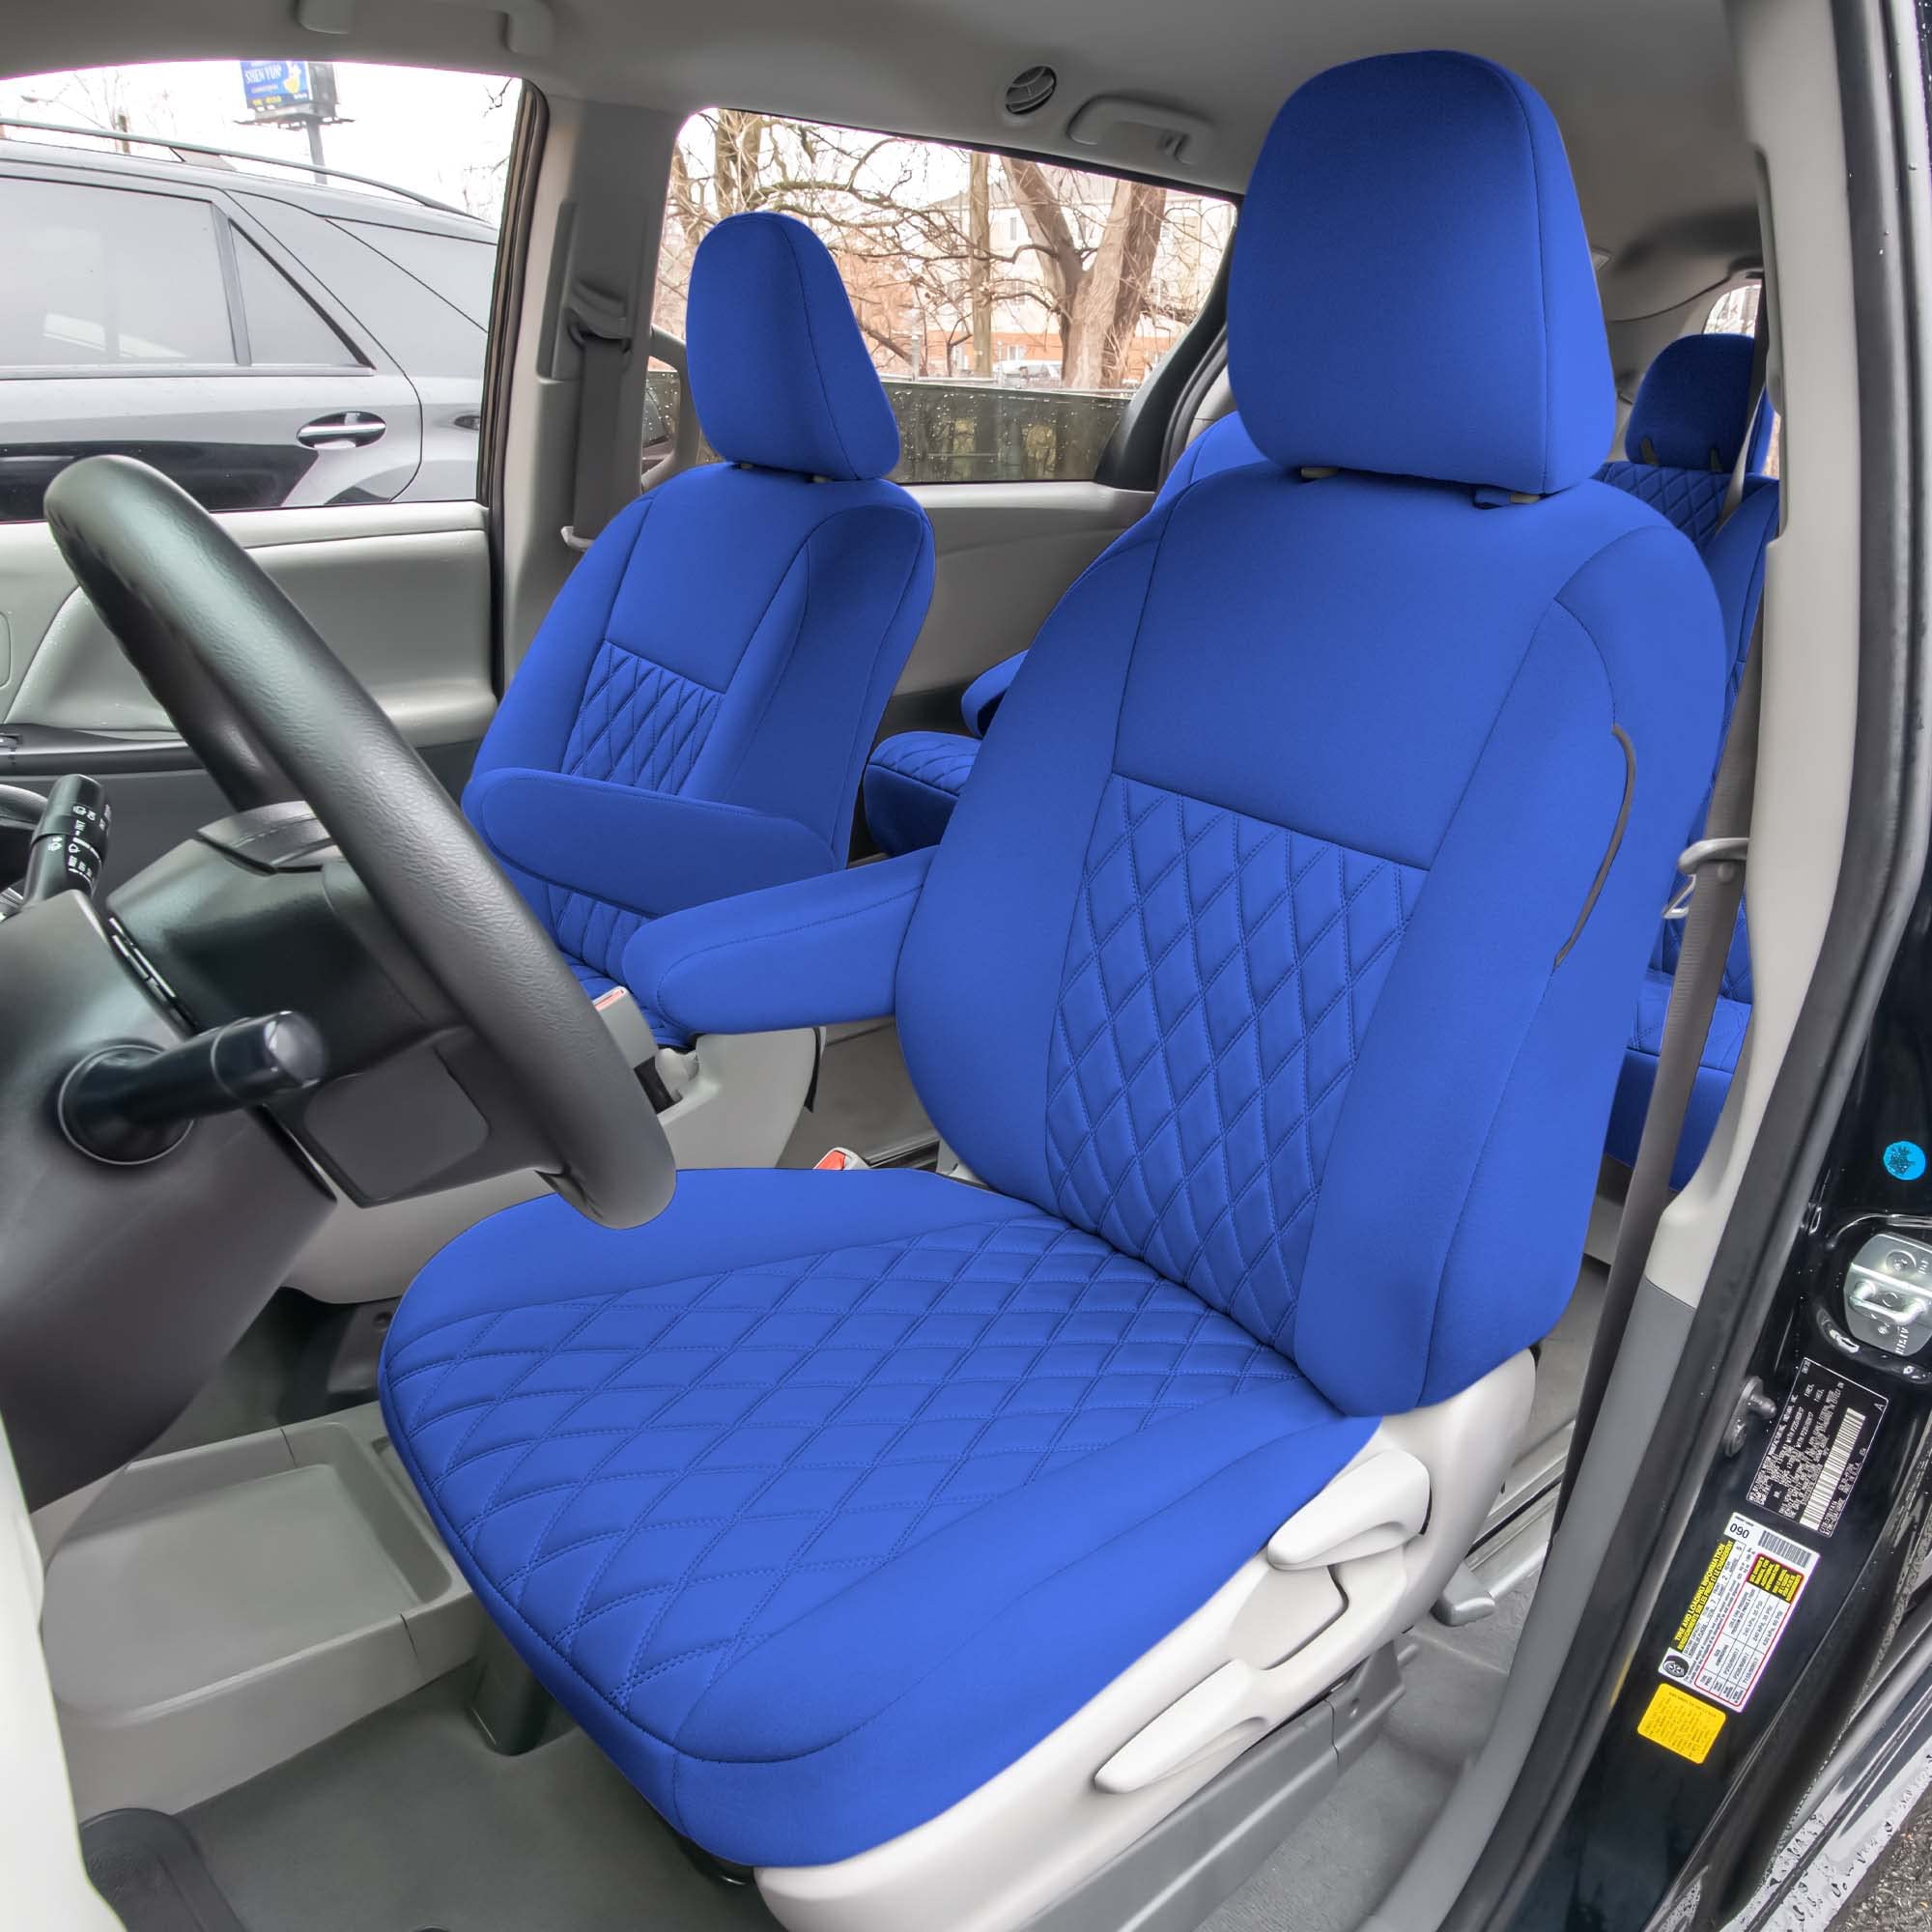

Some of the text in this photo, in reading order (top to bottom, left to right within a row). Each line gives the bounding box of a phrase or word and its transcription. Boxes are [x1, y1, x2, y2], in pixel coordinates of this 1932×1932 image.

[244, 68, 265, 84] SHEN
[1874, 1401, 1885, 1411] A
[1729, 1522, 1750, 1539] 090
[1674, 1543, 1725, 1641] TIRE AND LOADING INFORMATION
